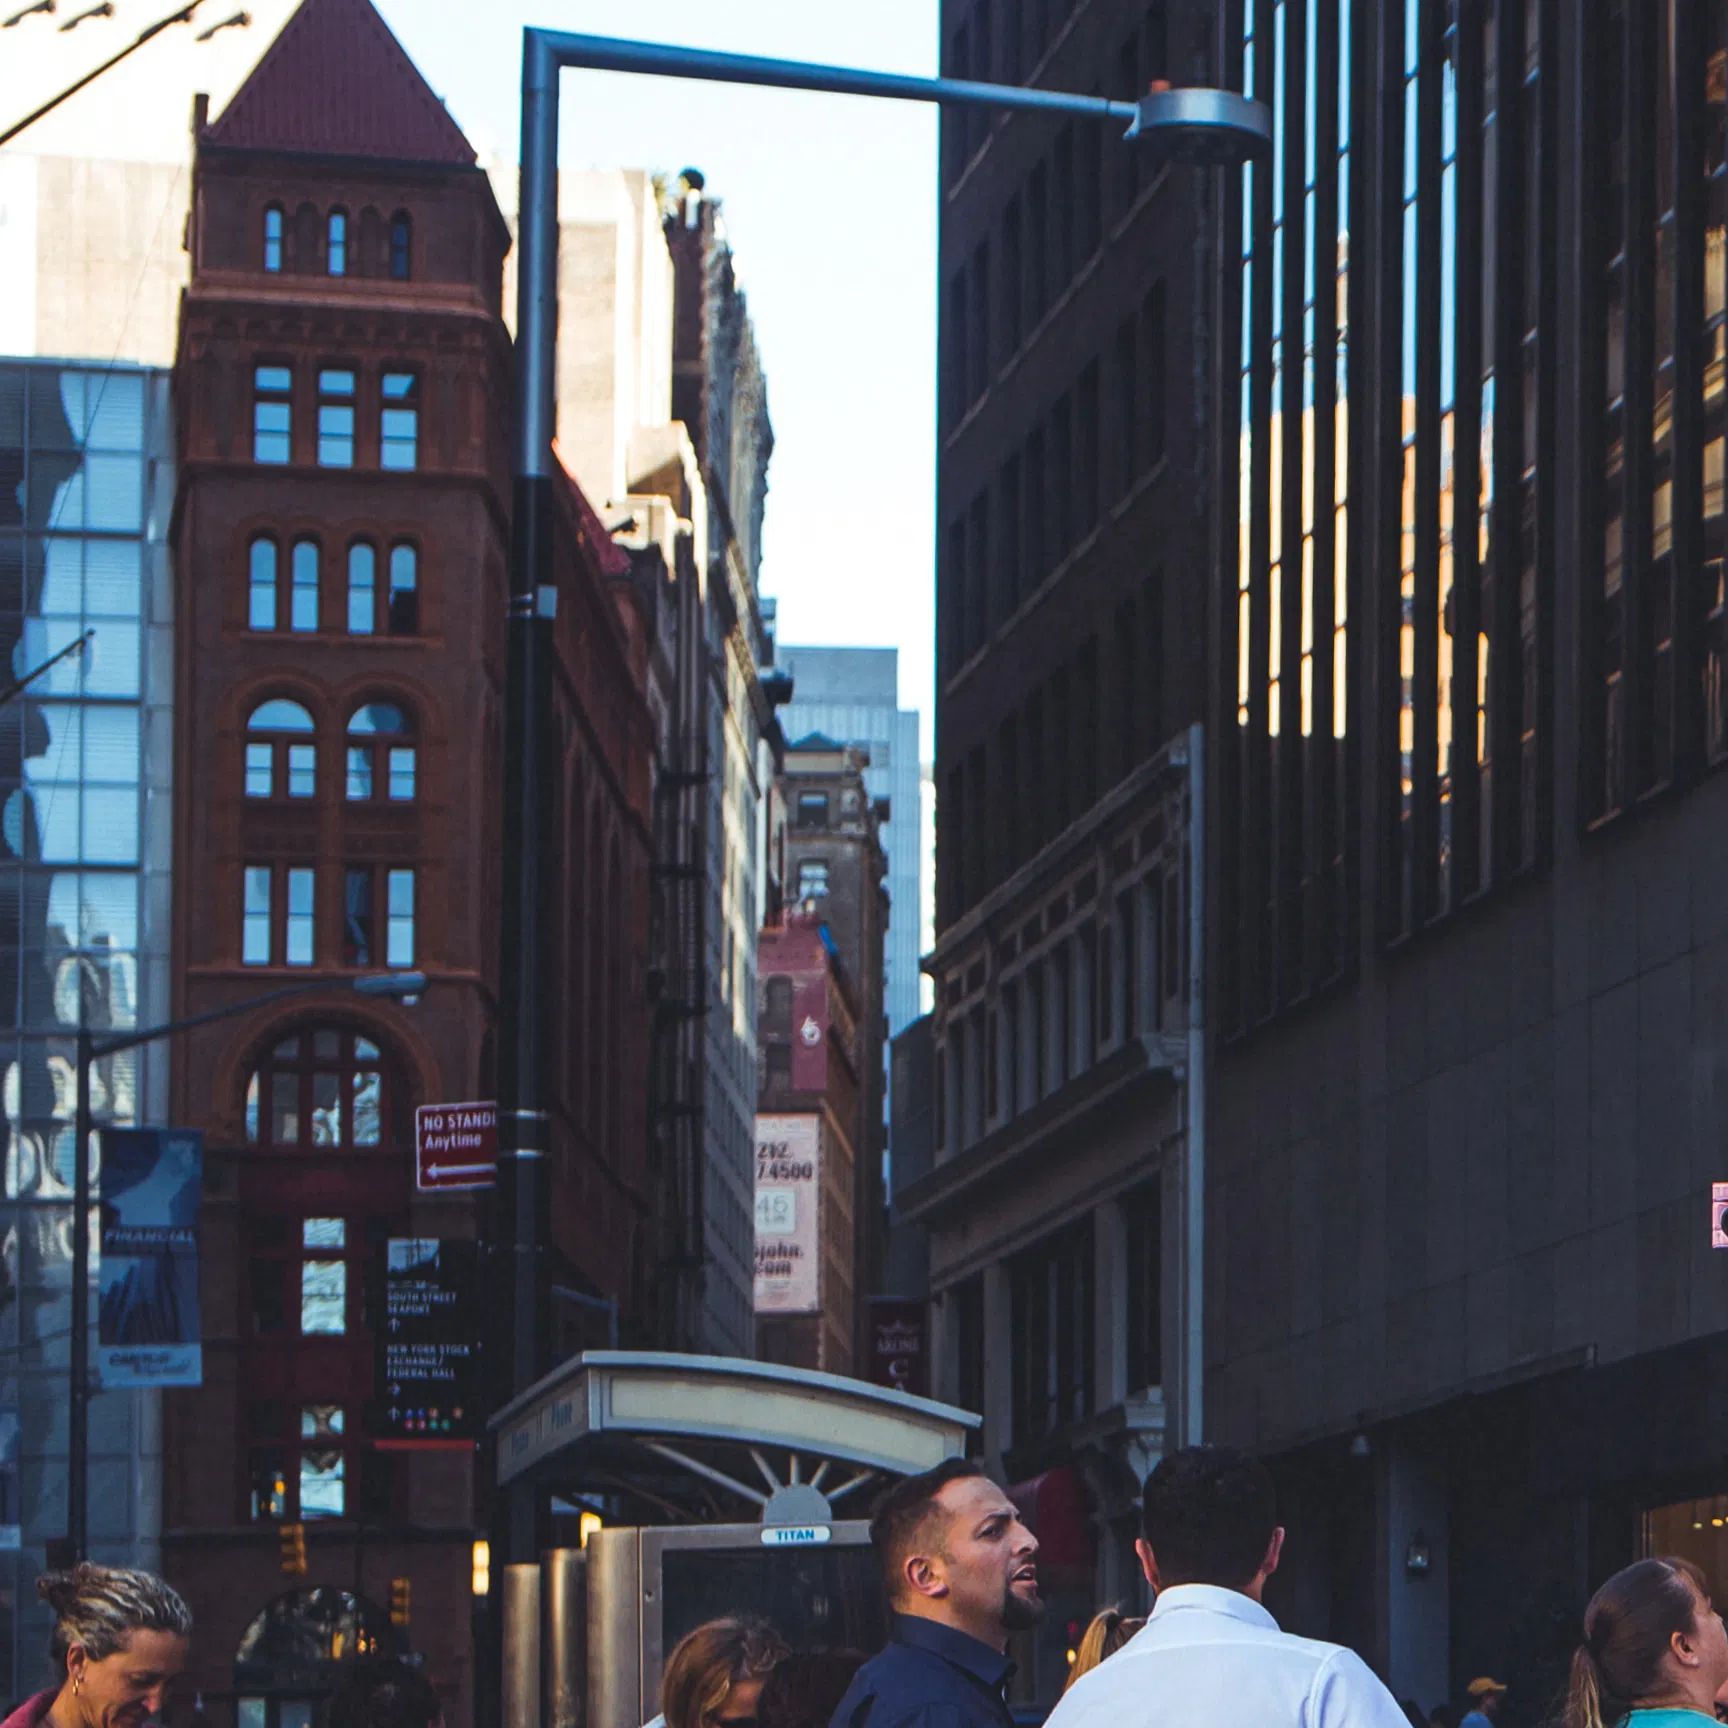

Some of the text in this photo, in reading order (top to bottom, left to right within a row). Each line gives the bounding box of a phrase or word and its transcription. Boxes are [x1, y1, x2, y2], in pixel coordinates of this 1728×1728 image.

[424, 1115, 443, 1131] NO
[425, 1132, 482, 1153] Anytime
[776, 1528, 815, 1541] TITAN
